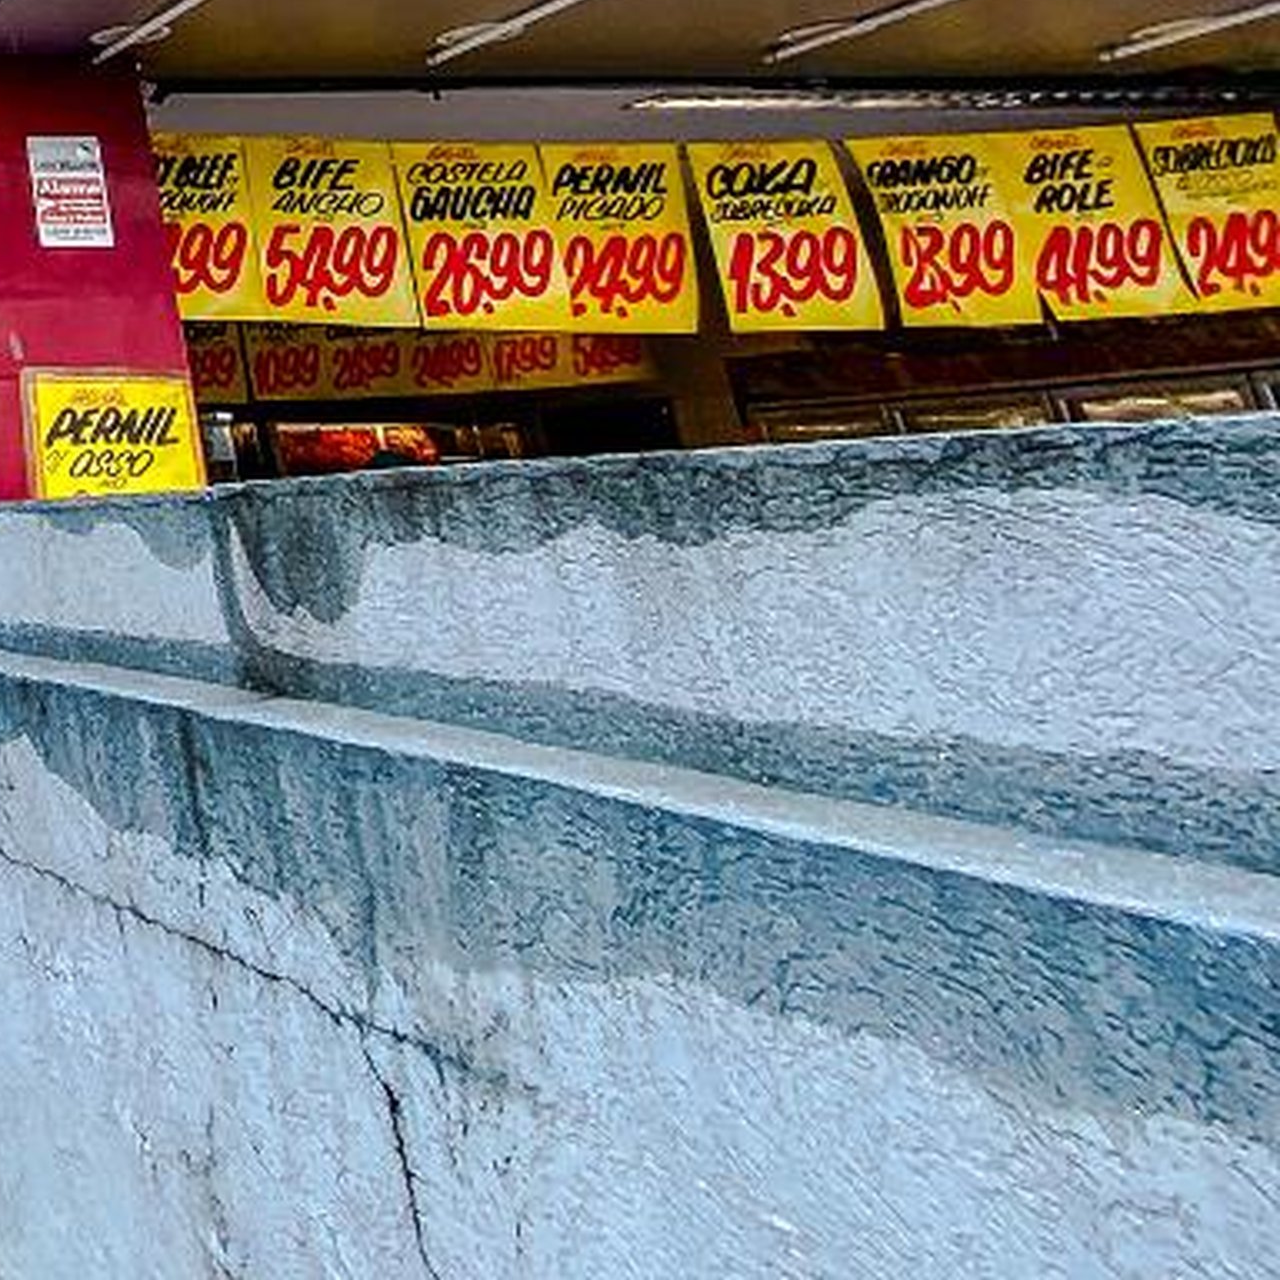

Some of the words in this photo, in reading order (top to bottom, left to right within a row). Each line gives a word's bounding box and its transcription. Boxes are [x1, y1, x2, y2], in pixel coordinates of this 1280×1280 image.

[273, 158, 360, 191] BIFE
[406, 159, 528, 184] COSTELA
[552, 162, 668, 197] PERNIL
[706, 158, 817, 199] COXA
[867, 154, 976, 188] FRANGO
[1024, 149, 1094, 184] BIFE
[273, 191, 384, 217] ANCHO
[555, 195, 665, 221] PICADO
[1034, 179, 1115, 214] ROLE
[45, 407, 179, 449] PERNIL
